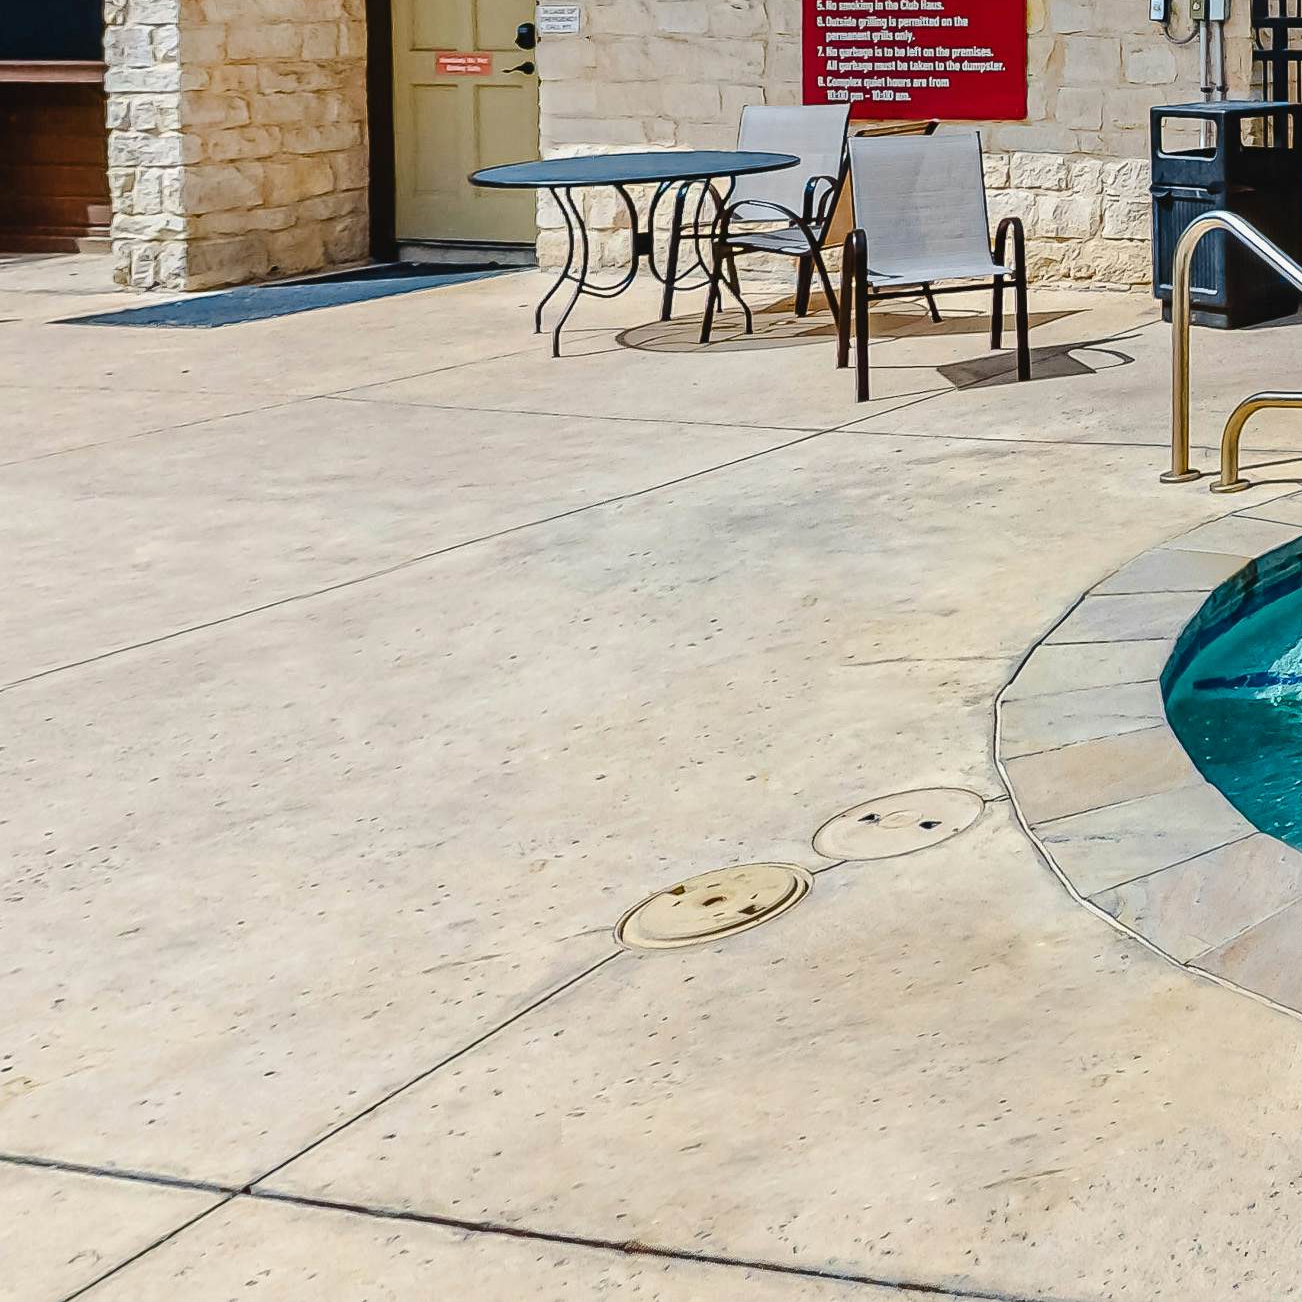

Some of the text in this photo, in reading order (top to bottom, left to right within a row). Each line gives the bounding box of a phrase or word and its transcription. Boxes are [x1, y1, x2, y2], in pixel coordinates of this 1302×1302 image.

[816, 0, 825, 10] 5.
[826, 0, 837, 10] No
[839, 0, 873, 13] smoking
[875, 0, 883, 10] in
[885, 0, 899, 10] the
[900, 0, 919, 10] Club
[826, 16, 856, 27] Outside
[858, 16, 887, 30] grilling
[889, 16, 897, 27] is
[898, 16, 939, 29] permitted
[941, 18, 952, 27] on
[954, 16, 968, 27] the
[872, 30, 893, 43] grills
[895, 30, 915, 43] only.
[817, 46, 994, 59] 7. No garbage is to be left on the premises.
[826, 60, 1006, 73] All garbage must be taken to the dumpster.
[827, 76, 862, 89] Complex
[863, 76, 885, 89] quiet
[886, 77, 911, 87] hours
[913, 78, 927, 87] are
[928, 76, 950, 87] from
